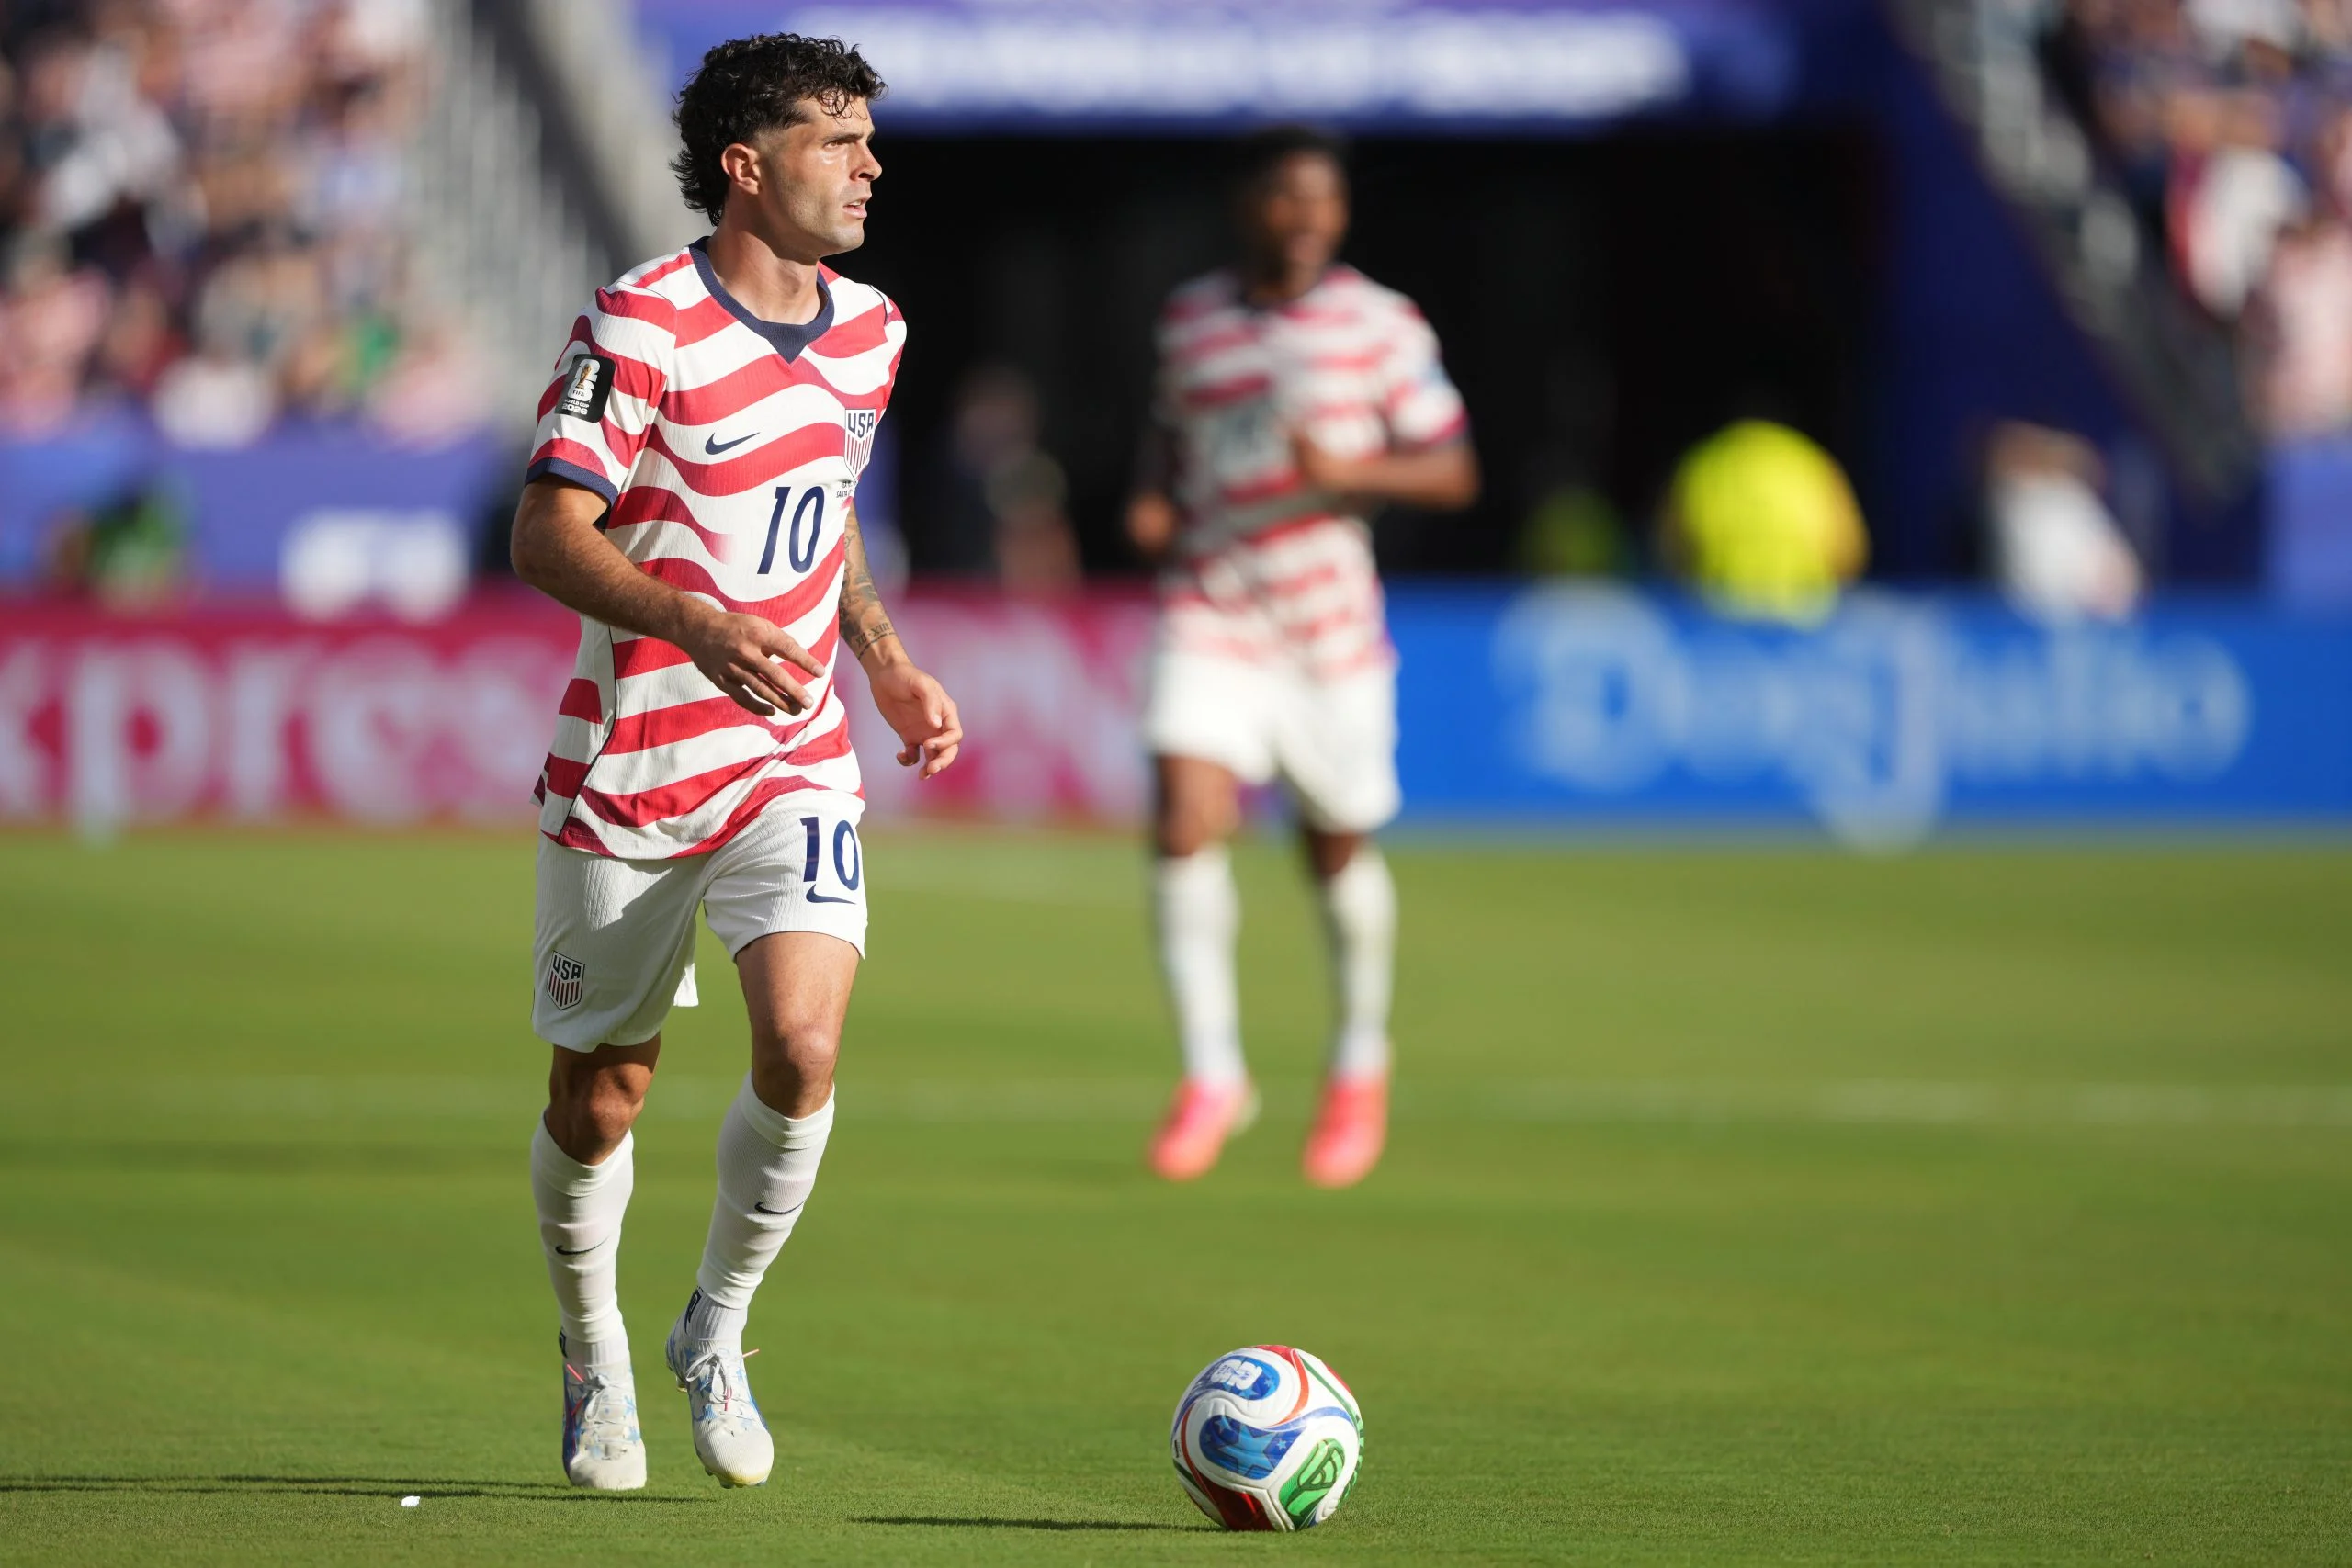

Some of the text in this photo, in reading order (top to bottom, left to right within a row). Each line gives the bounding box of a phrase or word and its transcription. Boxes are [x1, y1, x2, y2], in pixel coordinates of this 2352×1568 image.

[561, 403, 588, 415] 2026
[847, 412, 875, 439] USA
[756, 485, 825, 575] 10
[799, 815, 861, 892] 10
[552, 954, 582, 981] USA
